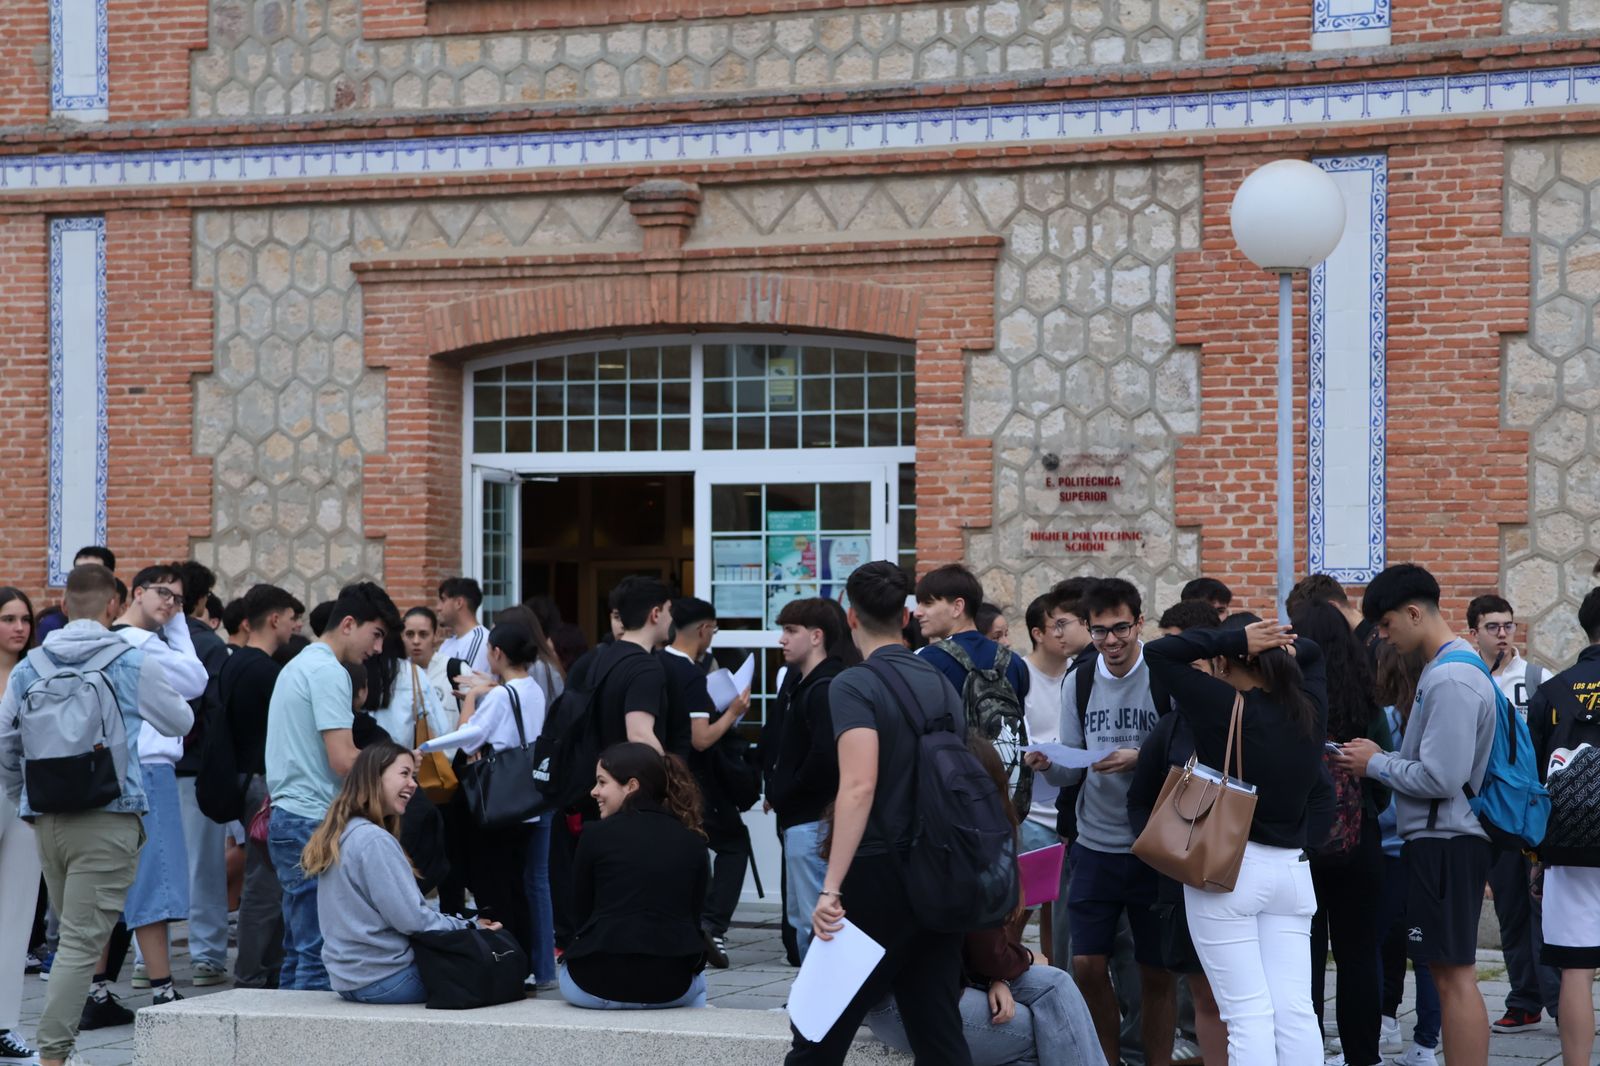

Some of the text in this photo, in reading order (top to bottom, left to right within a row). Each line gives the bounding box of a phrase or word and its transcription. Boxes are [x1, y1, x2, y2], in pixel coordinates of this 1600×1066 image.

[1045, 477, 1055, 488] E.
[1059, 491, 1107, 502] SUPERIOR
[1030, 531, 1143, 541] HIGHER POLYTECHNIC
[1065, 542, 1105, 552] SCHOOL
[1084, 708, 1156, 736] PEPE JEANS
